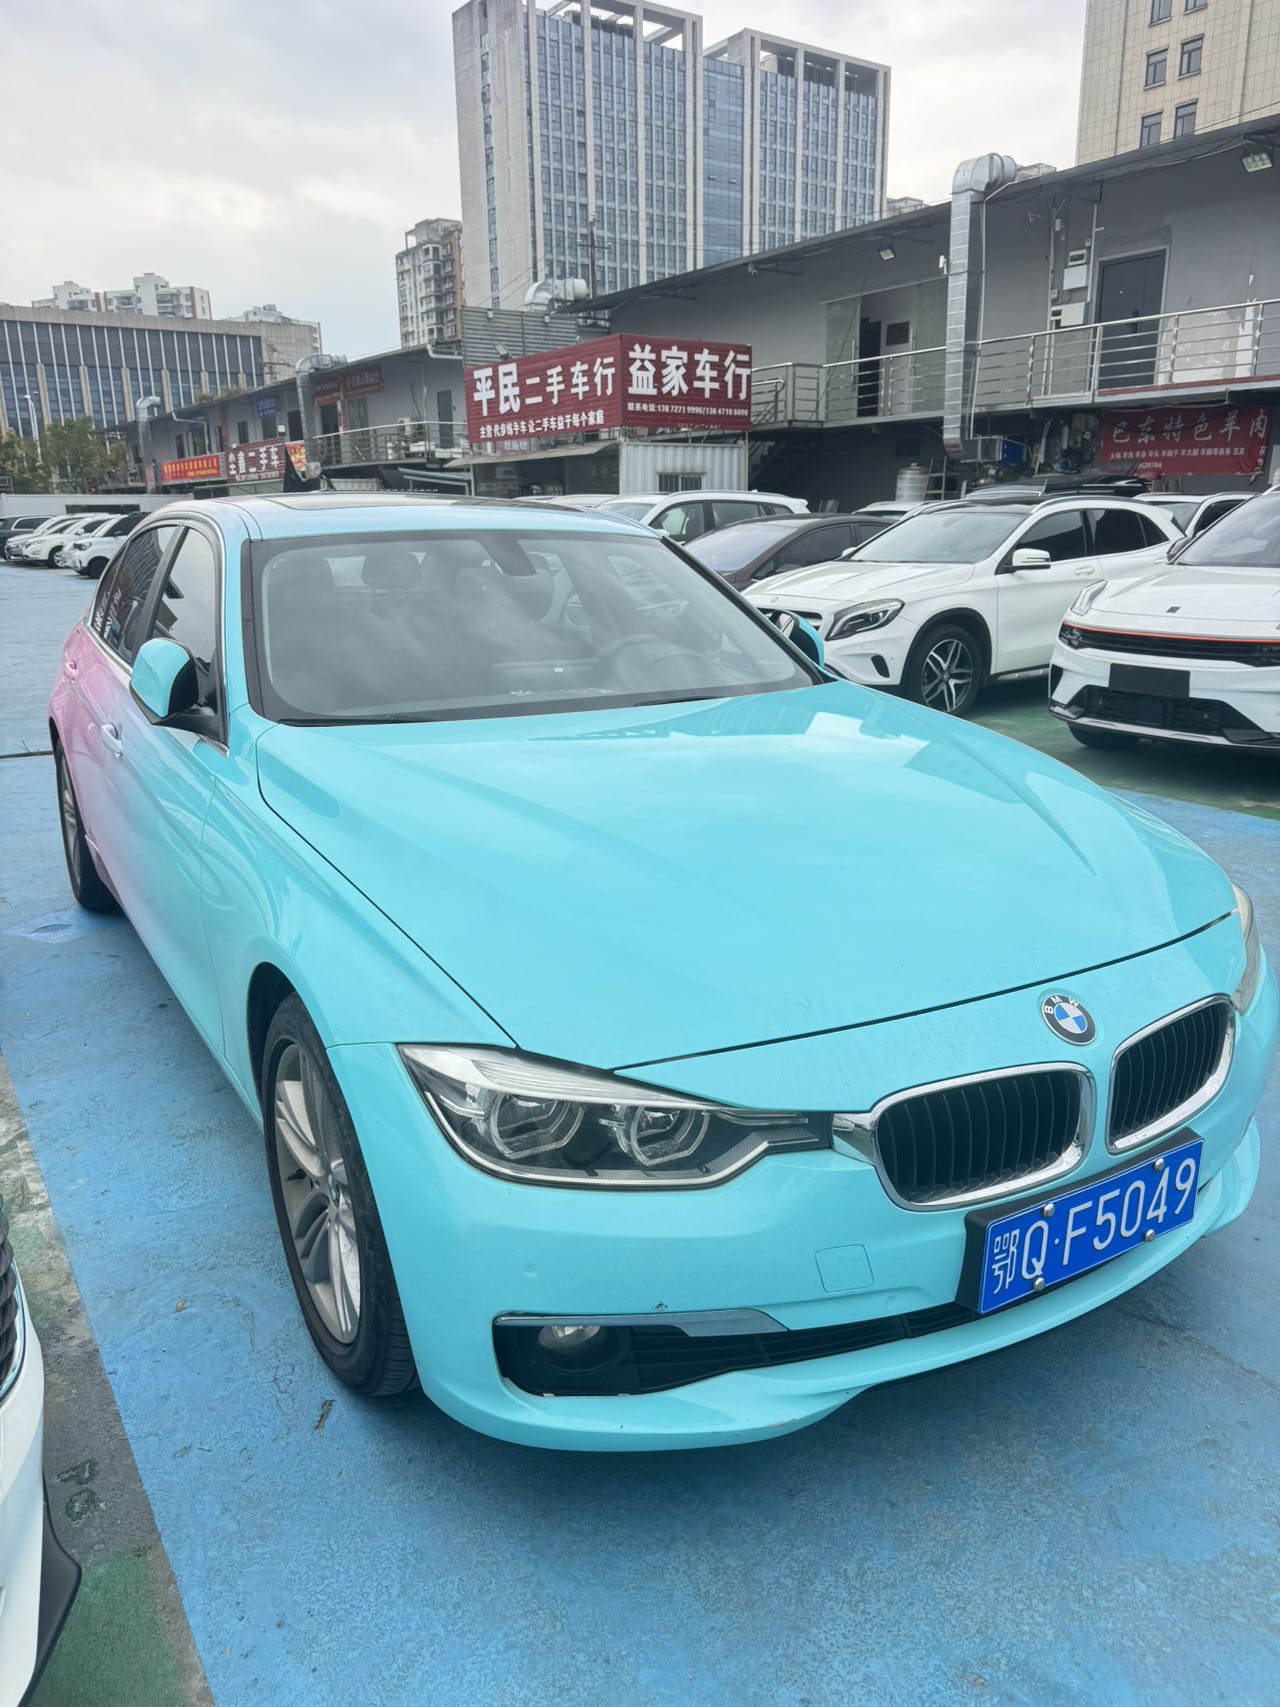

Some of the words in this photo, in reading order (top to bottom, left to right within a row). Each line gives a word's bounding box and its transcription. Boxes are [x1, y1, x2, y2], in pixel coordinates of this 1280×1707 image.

[473, 356, 616, 416] 平民二手车行
[628, 343, 750, 400] 益家车行
[1044, 995, 1079, 1015] BMW
[991, 1157, 1197, 1295] 鄂Q·F5049
